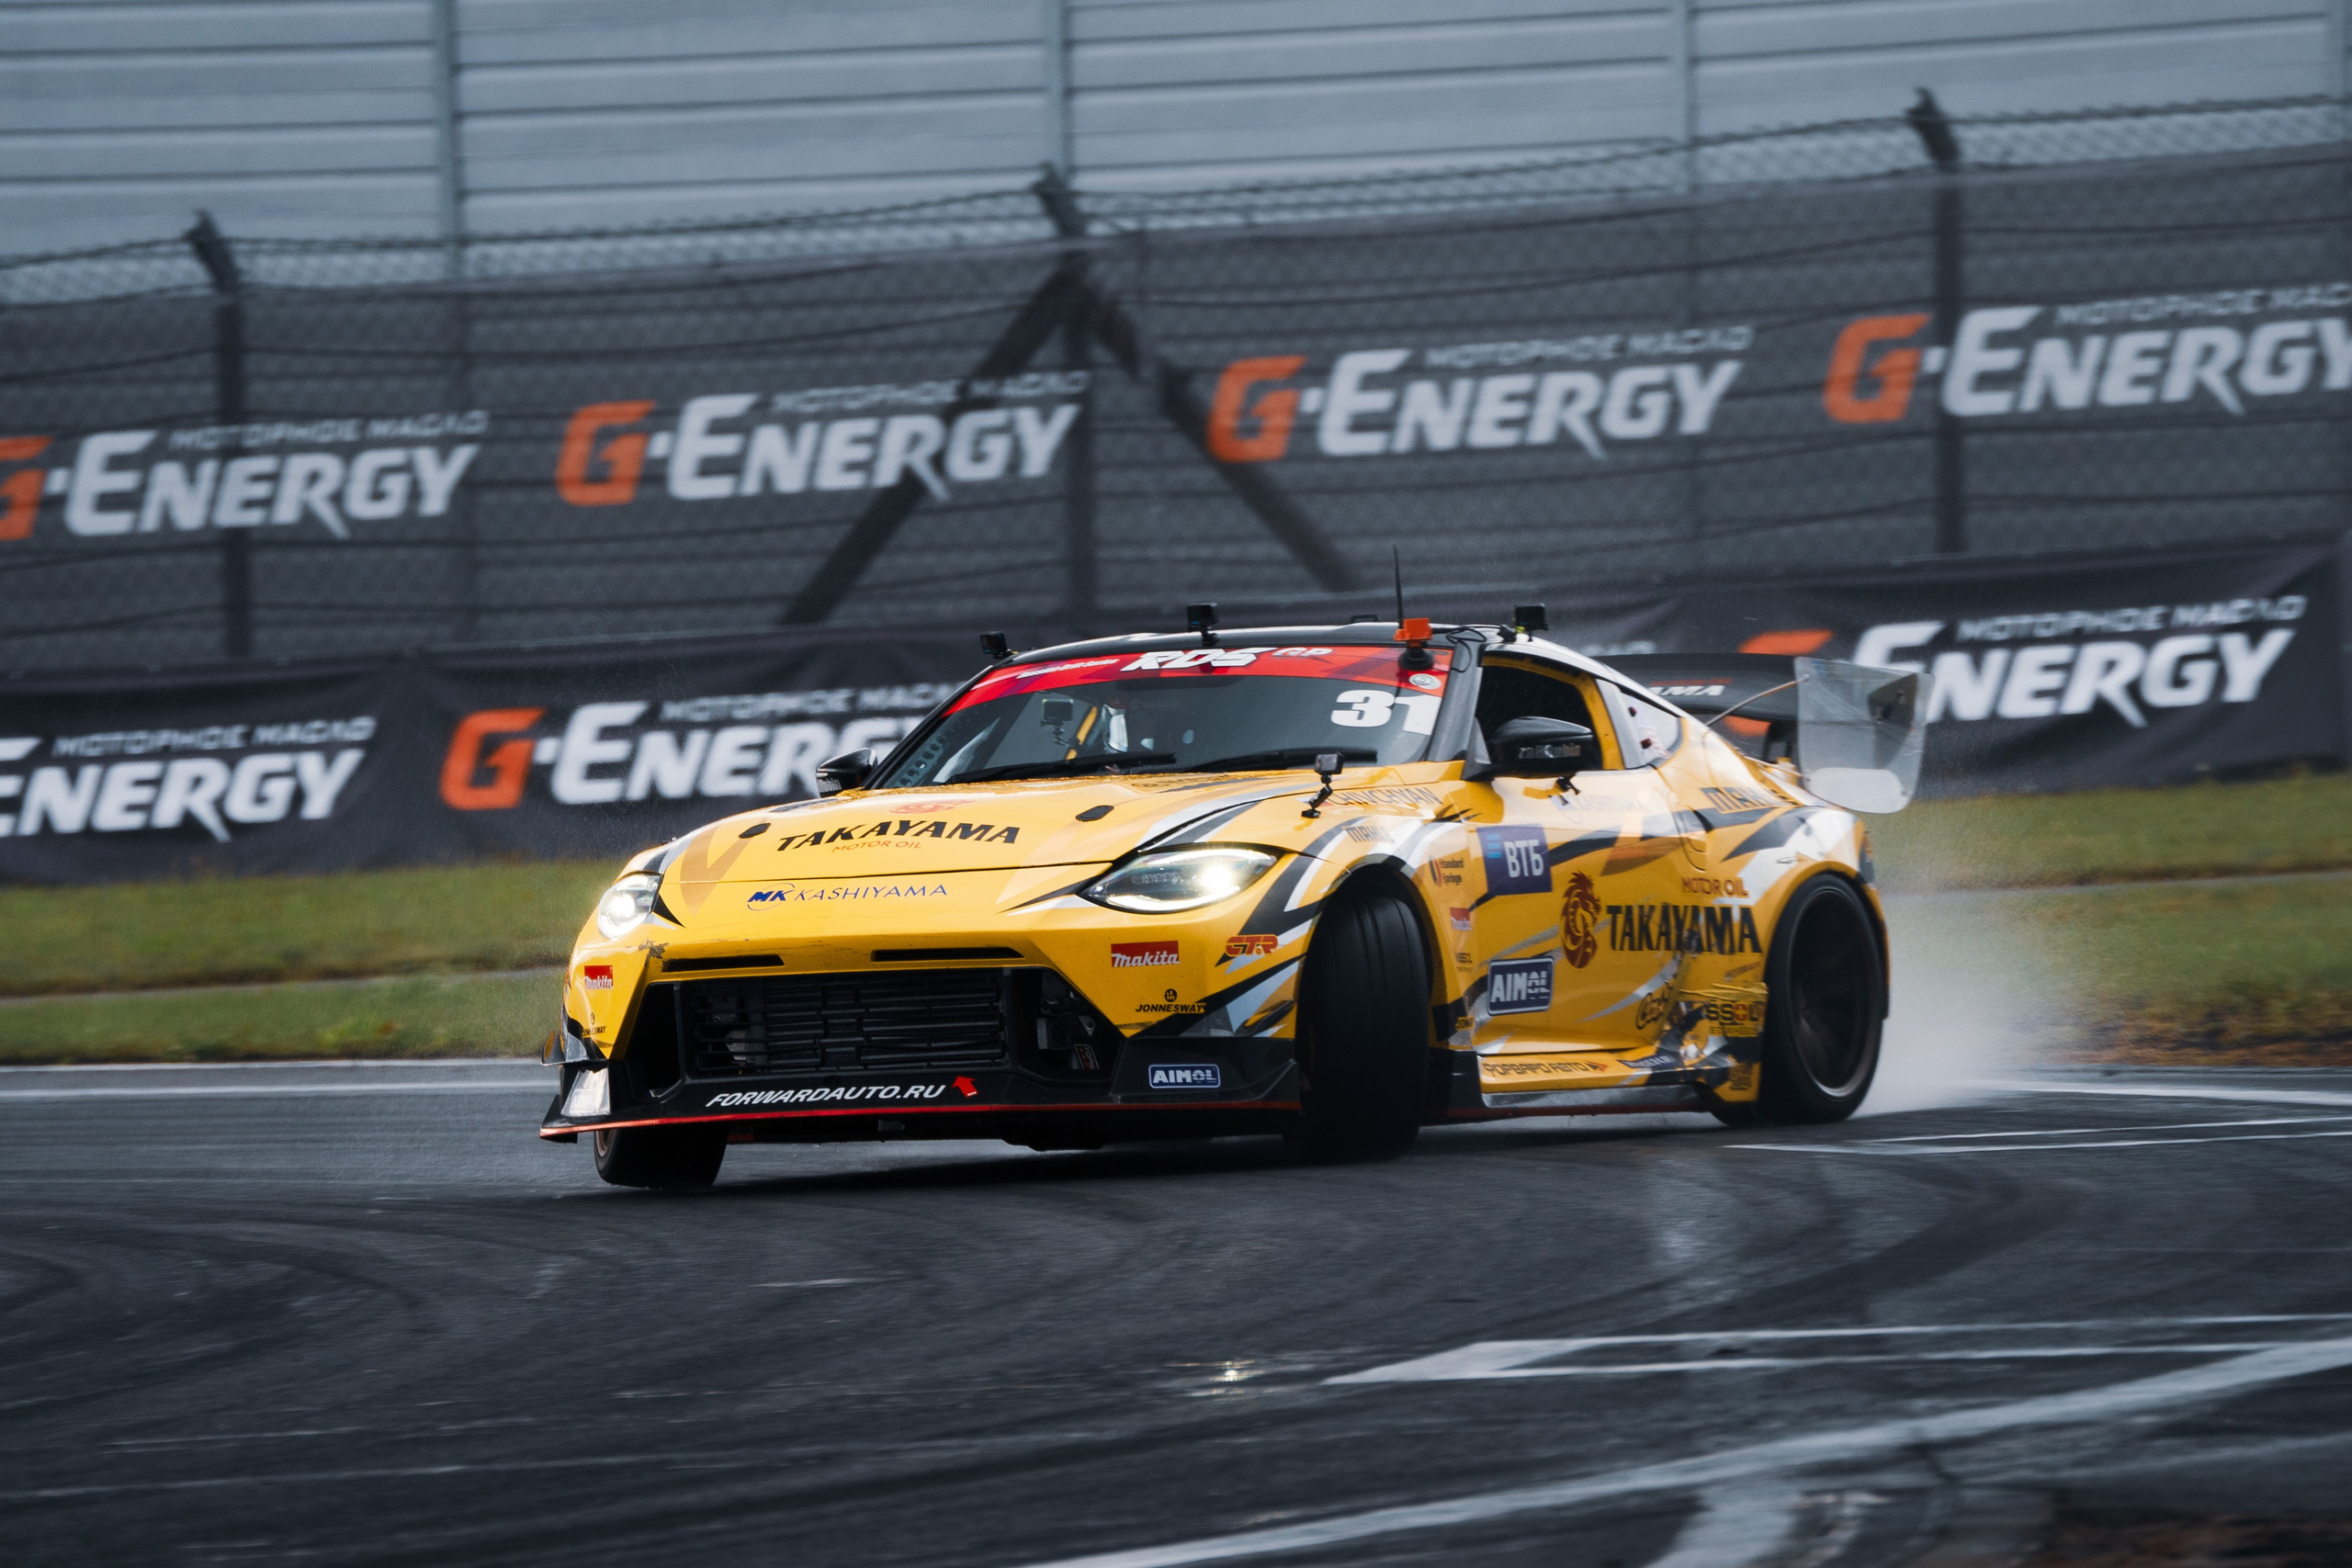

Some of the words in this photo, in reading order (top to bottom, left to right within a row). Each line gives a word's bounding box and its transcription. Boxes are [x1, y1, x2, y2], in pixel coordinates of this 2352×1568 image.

[1206, 348, 1744, 462] G-ENERGY
[555, 393, 1084, 506] G-ENERGY
[1120, 647, 1279, 672] RDS
[1330, 689, 1442, 735] 31
[776, 820, 1021, 852] TAKAYAMA
[831, 840, 890, 853] MOTOR
[895, 840, 922, 850] OIL
[1503, 839, 1544, 878] ВТБ
[794, 884, 948, 902] KASHIYAMA
[1682, 876, 1723, 896] MOTOR
[1723, 876, 1749, 897] OIL
[1606, 903, 1763, 955] TAKAYAMA
[1136, 1003, 1206, 1013] JONNESWAY
[1152, 1069, 1217, 1084] AIMOL
[706, 1085, 945, 1107] FORWARDAUTO.RU
